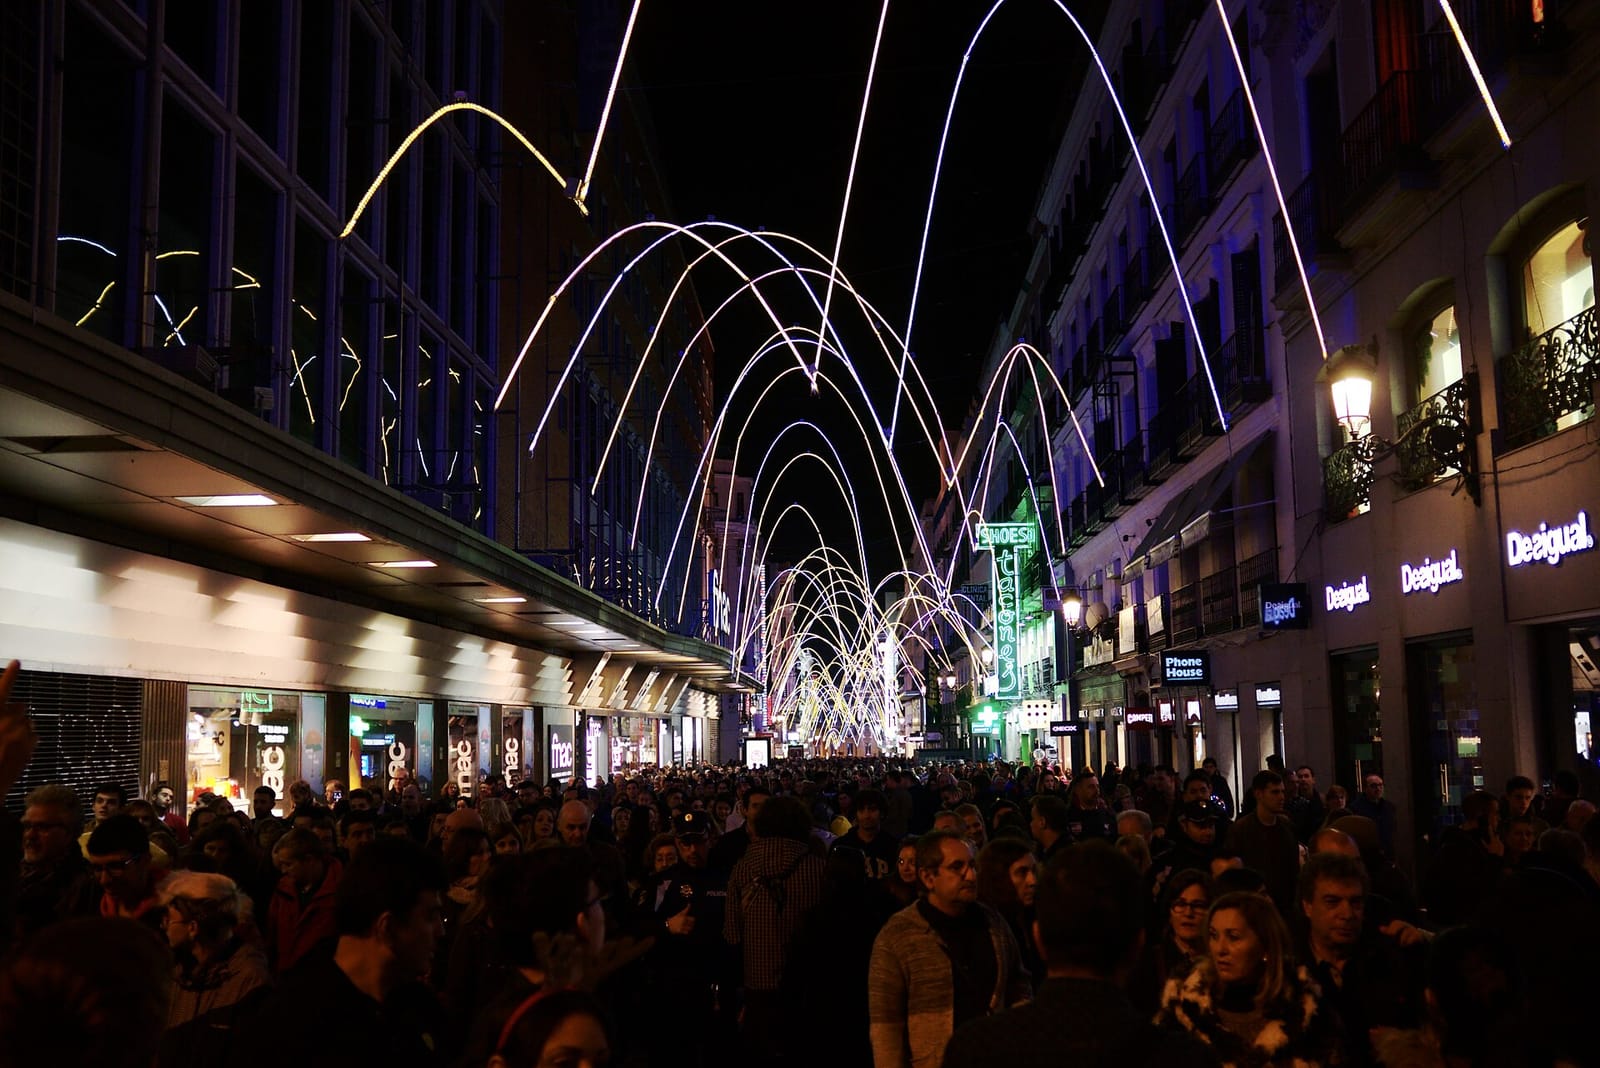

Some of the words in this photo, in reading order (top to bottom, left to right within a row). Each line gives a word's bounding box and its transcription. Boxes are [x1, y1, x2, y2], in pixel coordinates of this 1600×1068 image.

[980, 527, 1028, 544] SHOES
[1165, 657, 1202, 667] Phone
[1166, 667, 1203, 677] House
[551, 732, 573, 769] fnac
